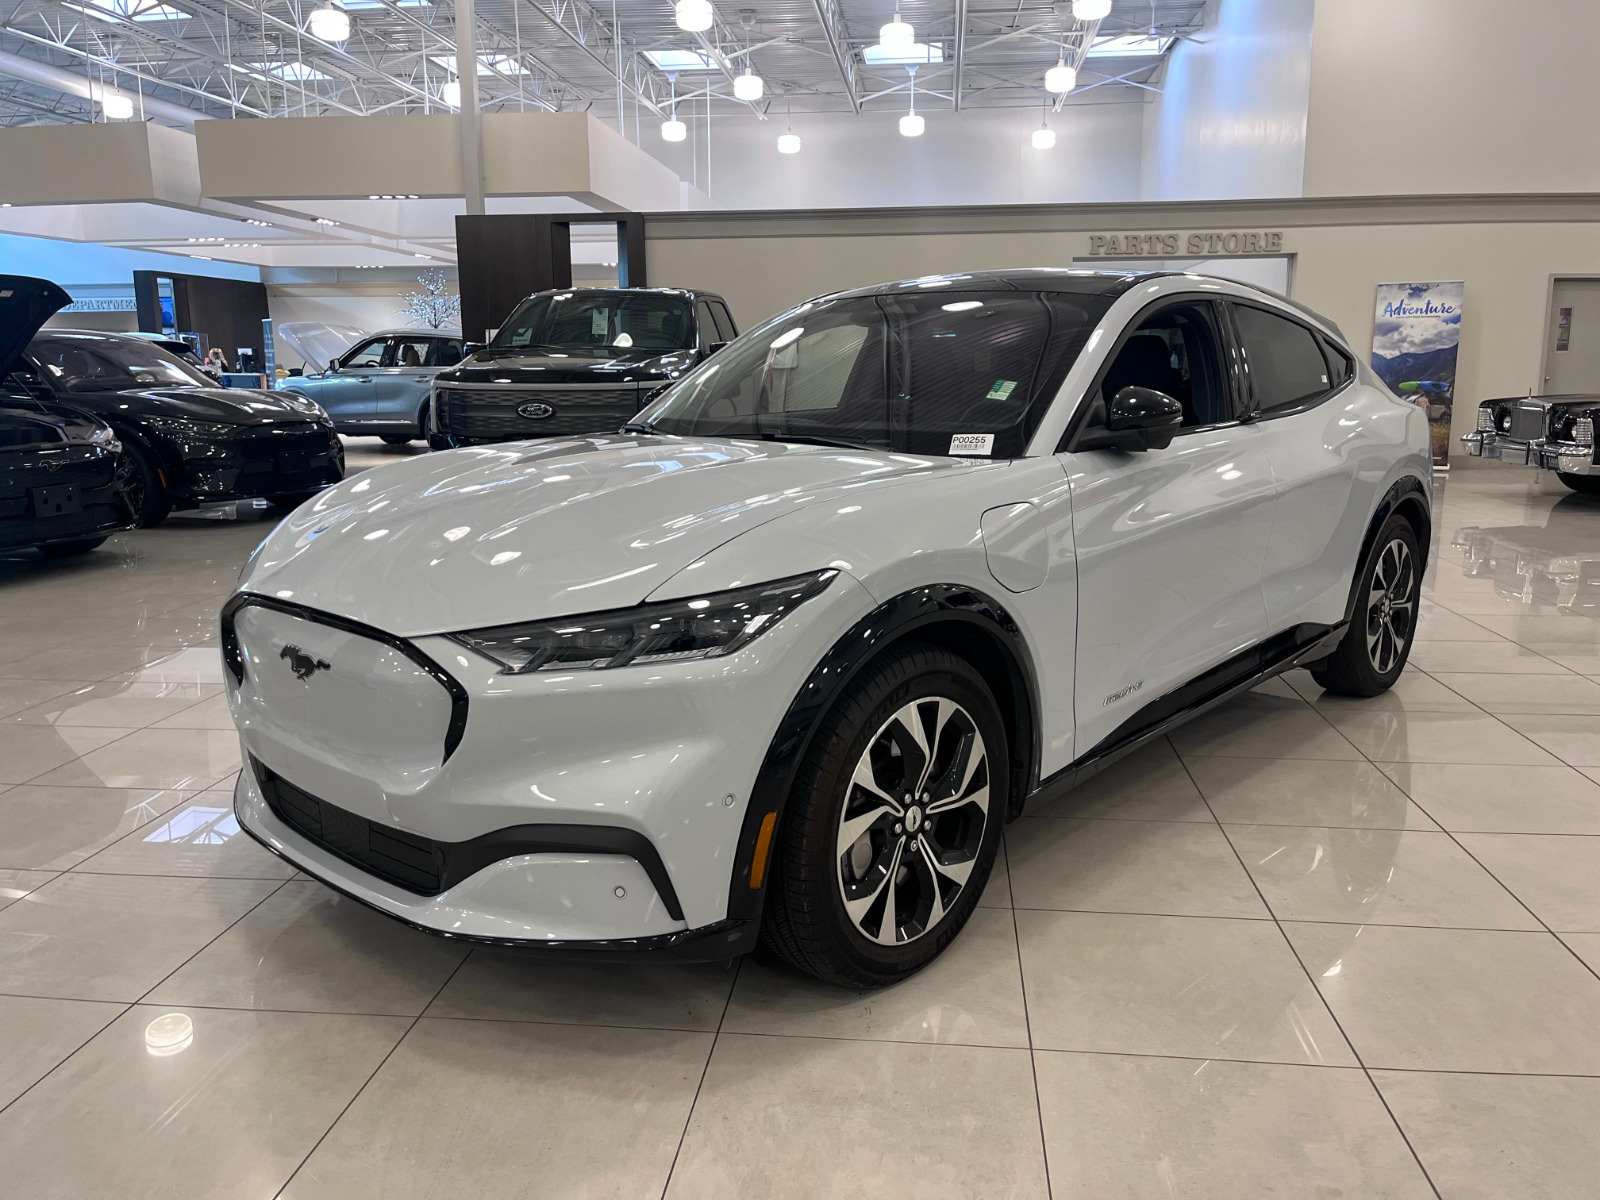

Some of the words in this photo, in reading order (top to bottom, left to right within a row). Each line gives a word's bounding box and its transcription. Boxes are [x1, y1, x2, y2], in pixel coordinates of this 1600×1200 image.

[1088, 233, 1179, 255] PARTS
[1187, 231, 1283, 254] STORE
[1384, 298, 1457, 317] Adventure
[952, 435, 987, 444] P00255
